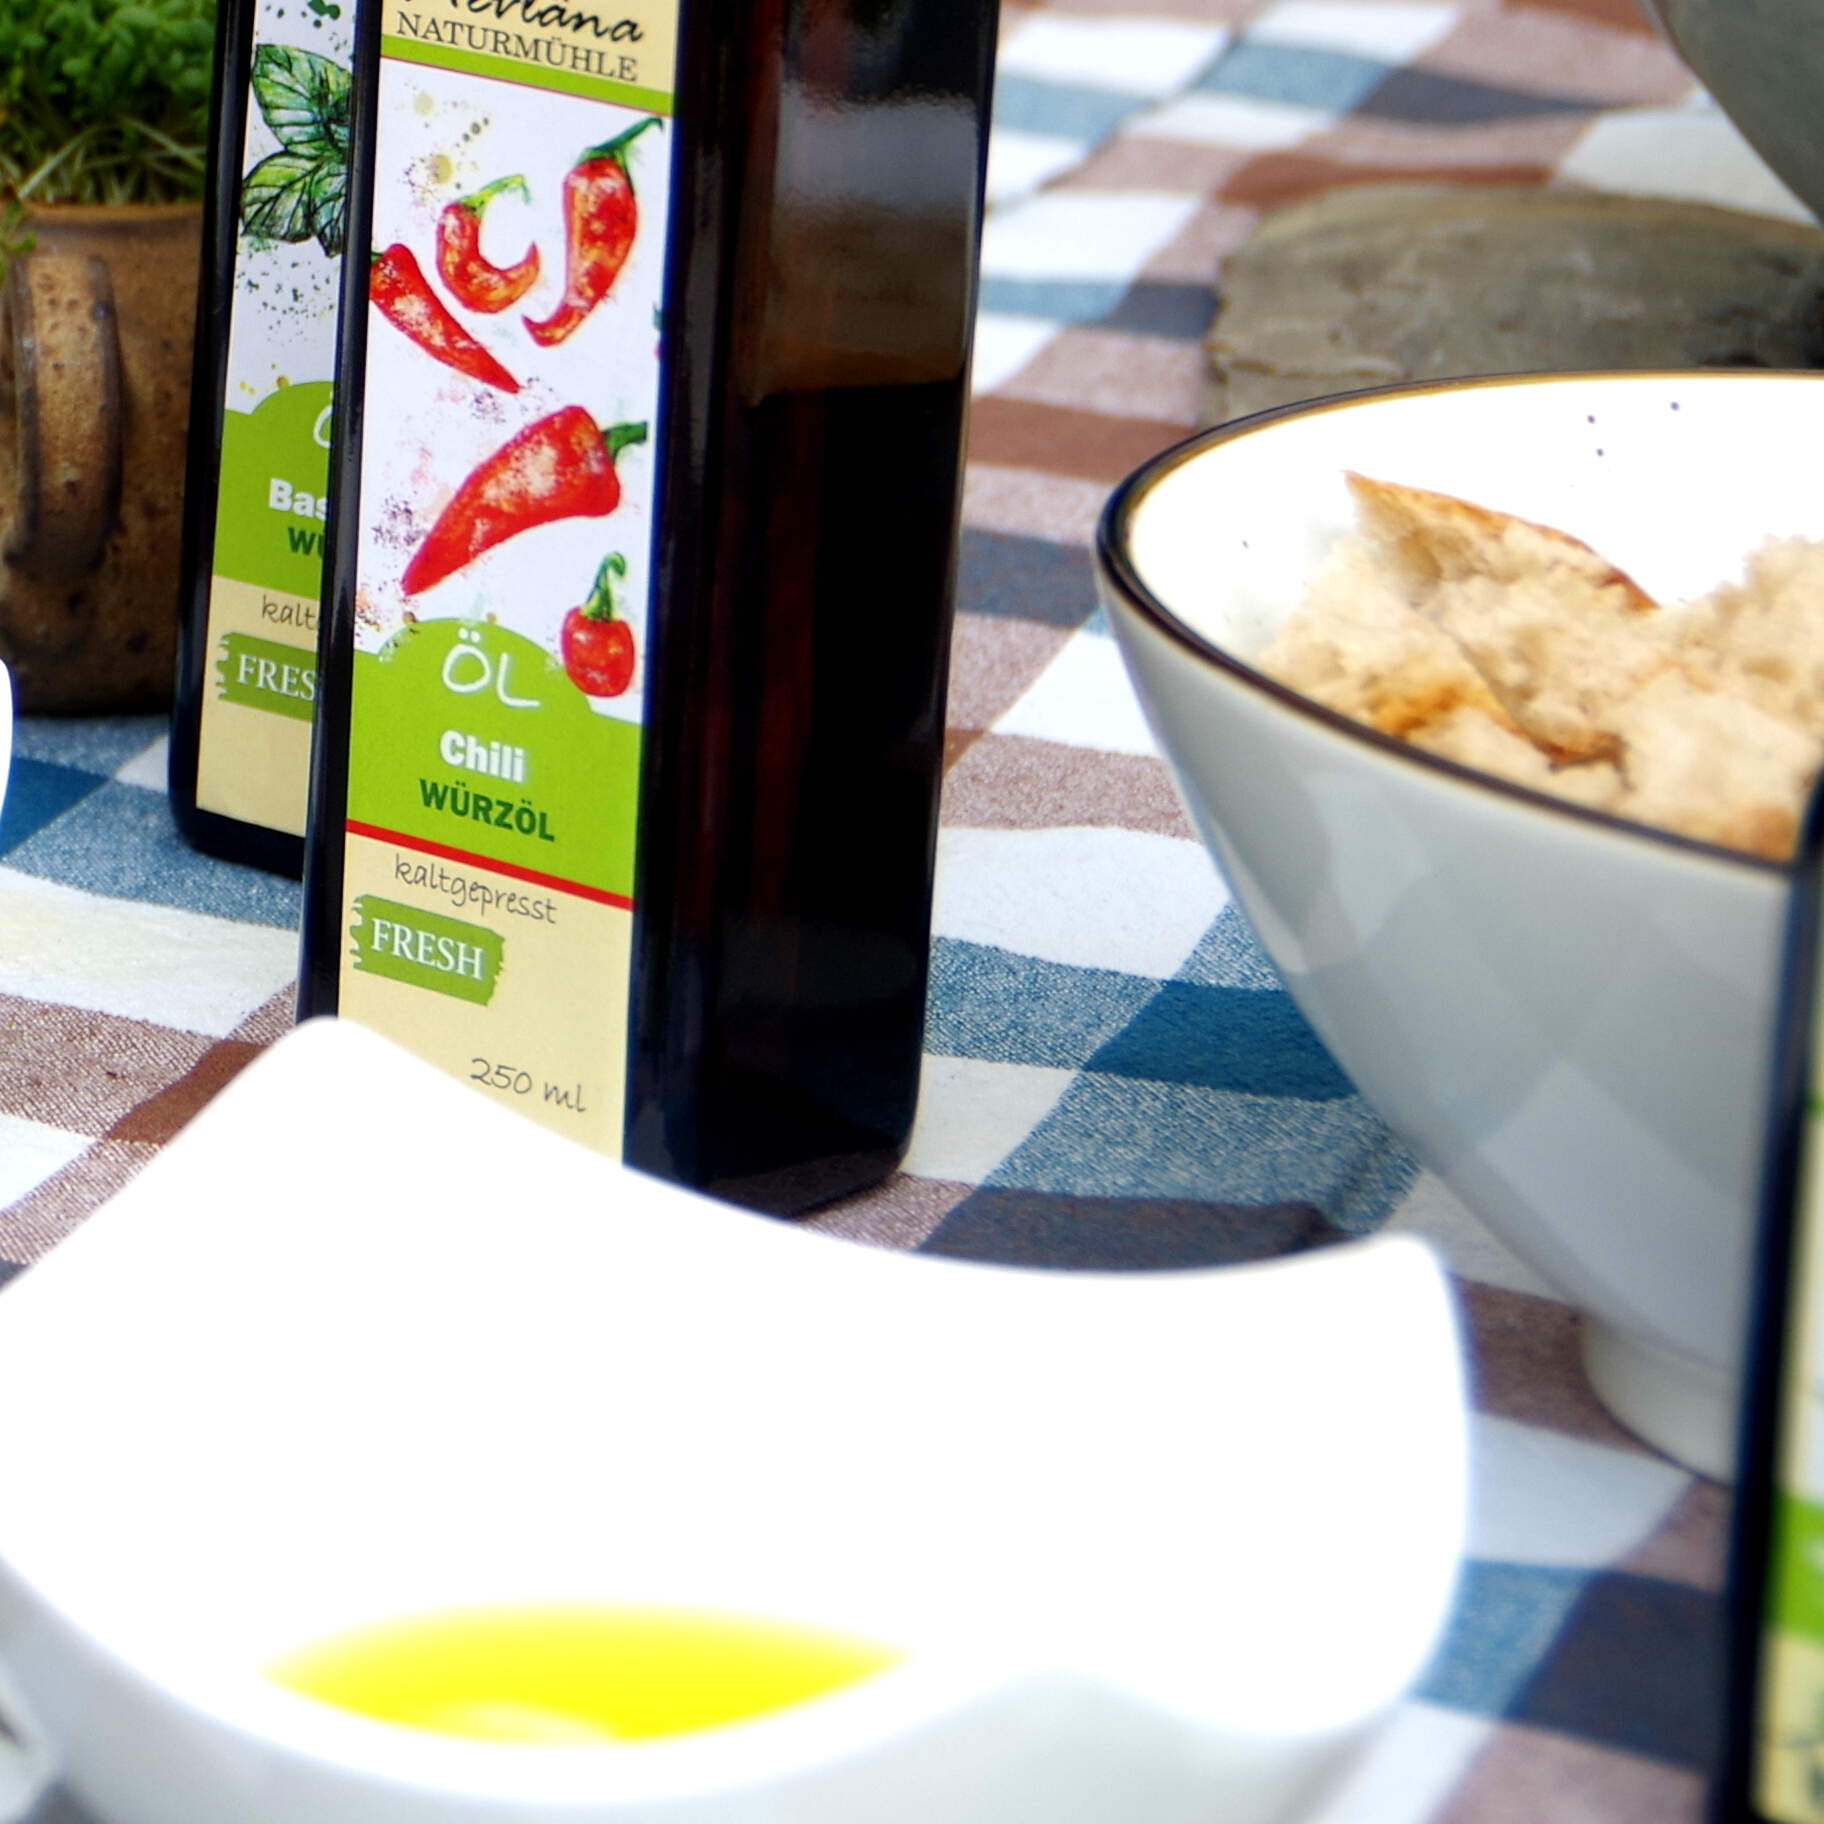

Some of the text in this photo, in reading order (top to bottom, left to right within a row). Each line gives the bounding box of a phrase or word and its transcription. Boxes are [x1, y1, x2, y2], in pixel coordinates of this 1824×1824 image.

[396, 10, 639, 83] NATURMÜHLE
[441, 627, 541, 709] ÖL
[438, 727, 527, 784] Chili
[418, 778, 557, 843] WÜRZÖL
[394, 852, 558, 925] kaltgepresst
[370, 917, 486, 981] FRESH
[469, 1057, 587, 1114] 250 ml
